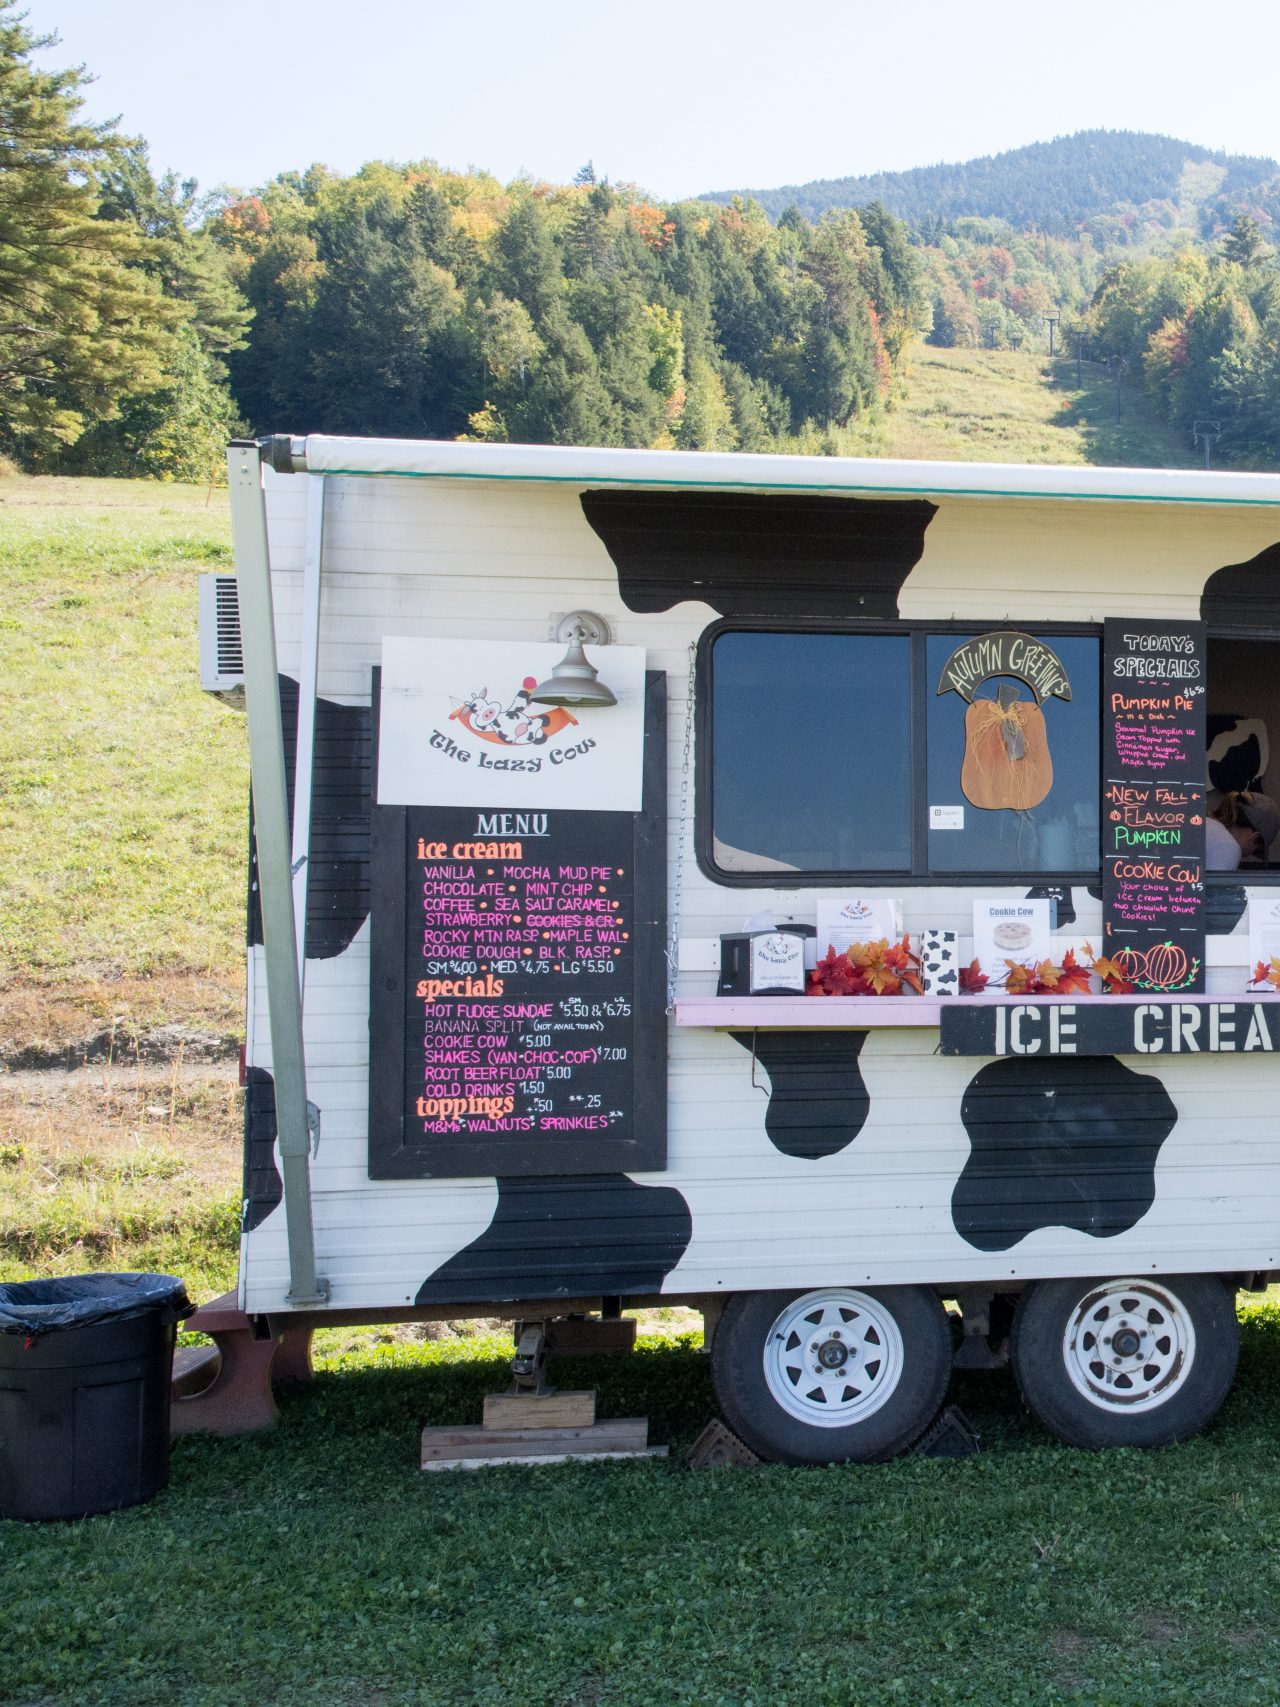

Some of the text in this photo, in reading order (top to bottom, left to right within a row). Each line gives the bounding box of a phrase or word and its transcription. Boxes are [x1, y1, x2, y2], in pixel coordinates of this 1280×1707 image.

[947, 639, 1069, 697] AUTUMN GREETINGS
[1113, 657, 1200, 678] SPECIALS
[1111, 693, 1194, 713] PUMPKIN PIE
[1115, 722, 1147, 733] Seasonal
[1151, 725, 1183, 736] Pumpkin
[1116, 733, 1136, 741] Cream
[1138, 735, 1163, 744] Topped
[1116, 741, 1153, 751] Cinnamon
[429, 729, 597, 773] The Lazy Cow
[1121, 757, 1145, 766] Maple
[1112, 786, 1188, 802] NEW FALL
[1123, 806, 1185, 824] FLAVOR
[477, 813, 549, 835] MENU
[1114, 826, 1181, 849] PUMPKIN
[417, 838, 523, 860] ice cream
[424, 866, 613, 880] VANILLA MOCHA MUD PIE
[1113, 861, 1165, 880] COOKIE
[423, 882, 593, 897] CHOCOLATE MINT CHIP
[1120, 881, 1140, 893] Your
[1142, 884, 1169, 892] choice
[1191, 882, 1204, 891] $5
[423, 897, 615, 913] COFFEE SEA SALT CARAMEL
[1113, 902, 1129, 910] two
[1132, 904, 1168, 913] chocolate
[1168, 895, 1201, 905] between
[424, 912, 513, 927] STRAWBERRY
[989, 907, 1034, 916] Cookie Cow
[424, 929, 471, 944] ROCKY
[473, 929, 503, 943] MTN
[550, 929, 593, 943] MAPLE
[422, 943, 473, 958] COOKIE
[476, 946, 521, 959] DOUGH
[426, 961, 450, 975] SM.
[490, 961, 519, 974] MED.
[521, 960, 550, 974] $4.75
[561, 961, 580, 974] LG
[582, 960, 615, 974] $5.50
[416, 974, 504, 1003] specials
[425, 1004, 453, 1018] HOT
[457, 1004, 500, 1018] FUDGE
[503, 1003, 554, 1018] SUNDAE
[559, 1001, 589, 1017] $5.50
[591, 1004, 602, 1017] &
[424, 1020, 480, 1034] BANANA
[485, 1020, 525, 1034] SPLIT
[553, 1022, 575, 1031] AVAIL
[996, 1005, 1077, 1055] ICE
[423, 1034, 551, 1049] COOKIE COW $5.00
[424, 1050, 481, 1064] SHAKES
[597, 1045, 627, 1060] $7.00
[424, 1066, 460, 1082] ROOT
[464, 1066, 498, 1080] BEER
[500, 1066, 542, 1080] FLOAT
[425, 1082, 461, 1098] COLD
[465, 1082, 515, 1097] DRINKS
[416, 1094, 515, 1121] toppings
